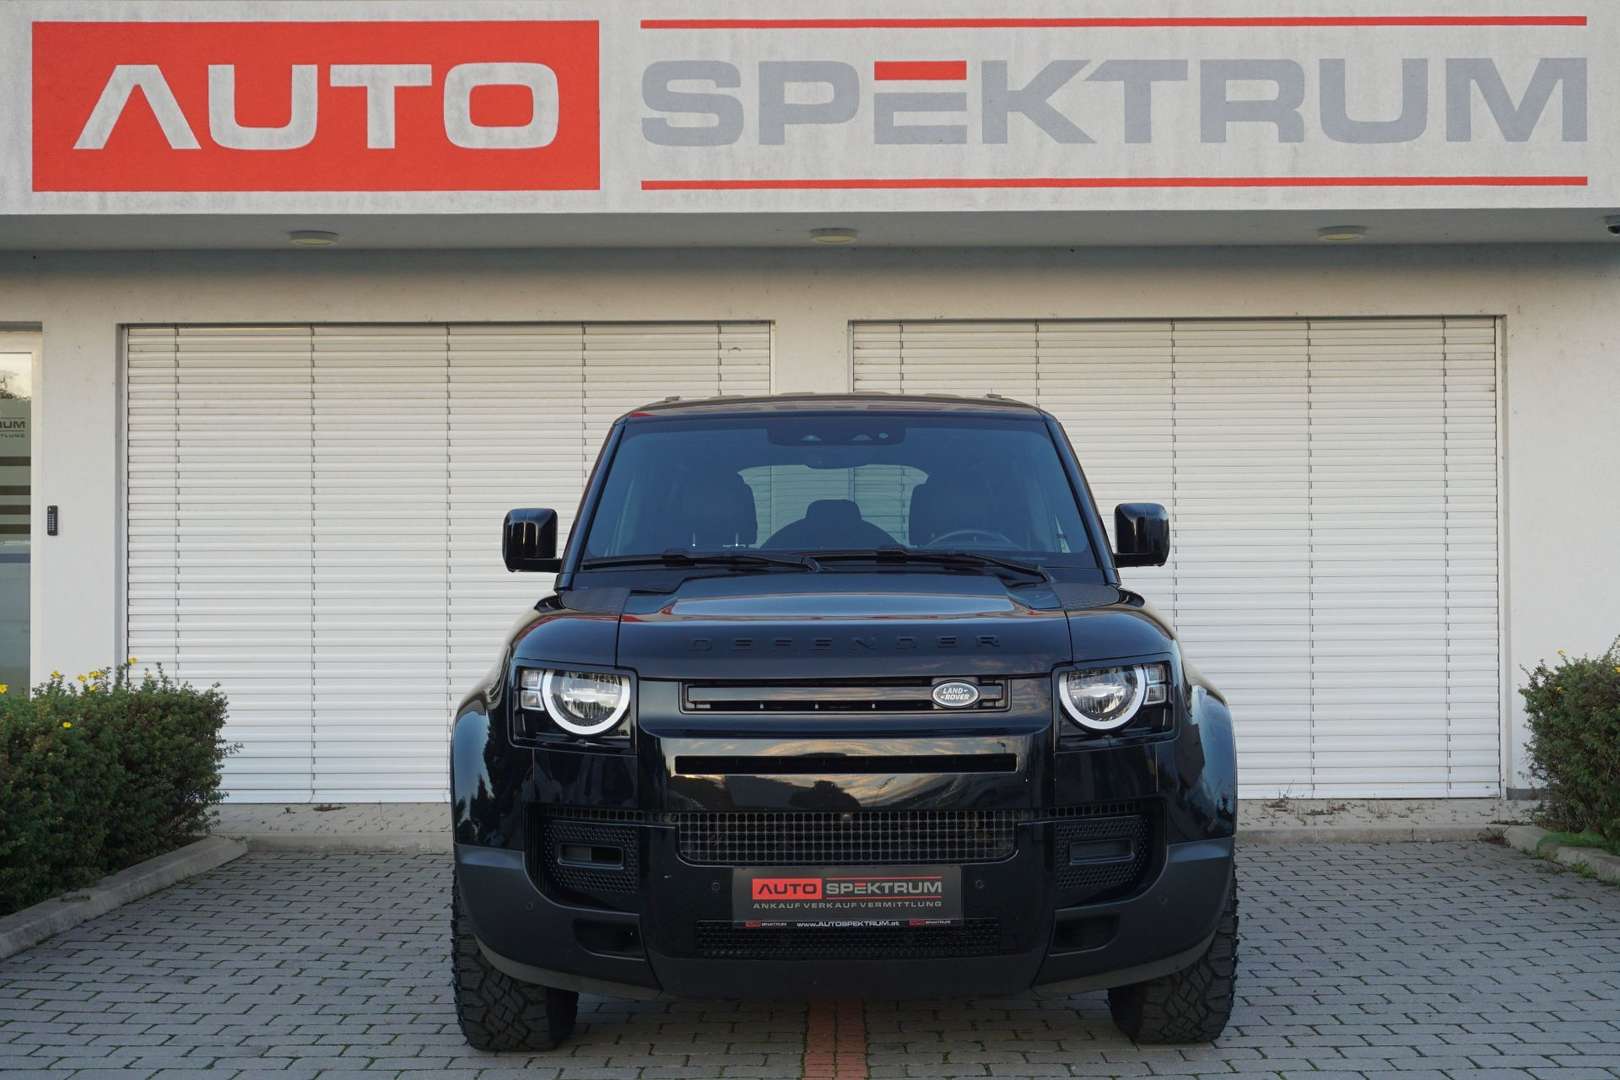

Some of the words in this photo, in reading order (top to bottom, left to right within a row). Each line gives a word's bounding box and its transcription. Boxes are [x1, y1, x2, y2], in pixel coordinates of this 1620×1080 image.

[73, 61, 560, 151] AUTO
[641, 57, 1588, 148] SPEKTRUM
[0, 421, 25, 429] UM
[690, 634, 1001, 652] DEFENDER
[758, 883, 817, 895] AUTO
[825, 881, 942, 895] SPEKTRUM
